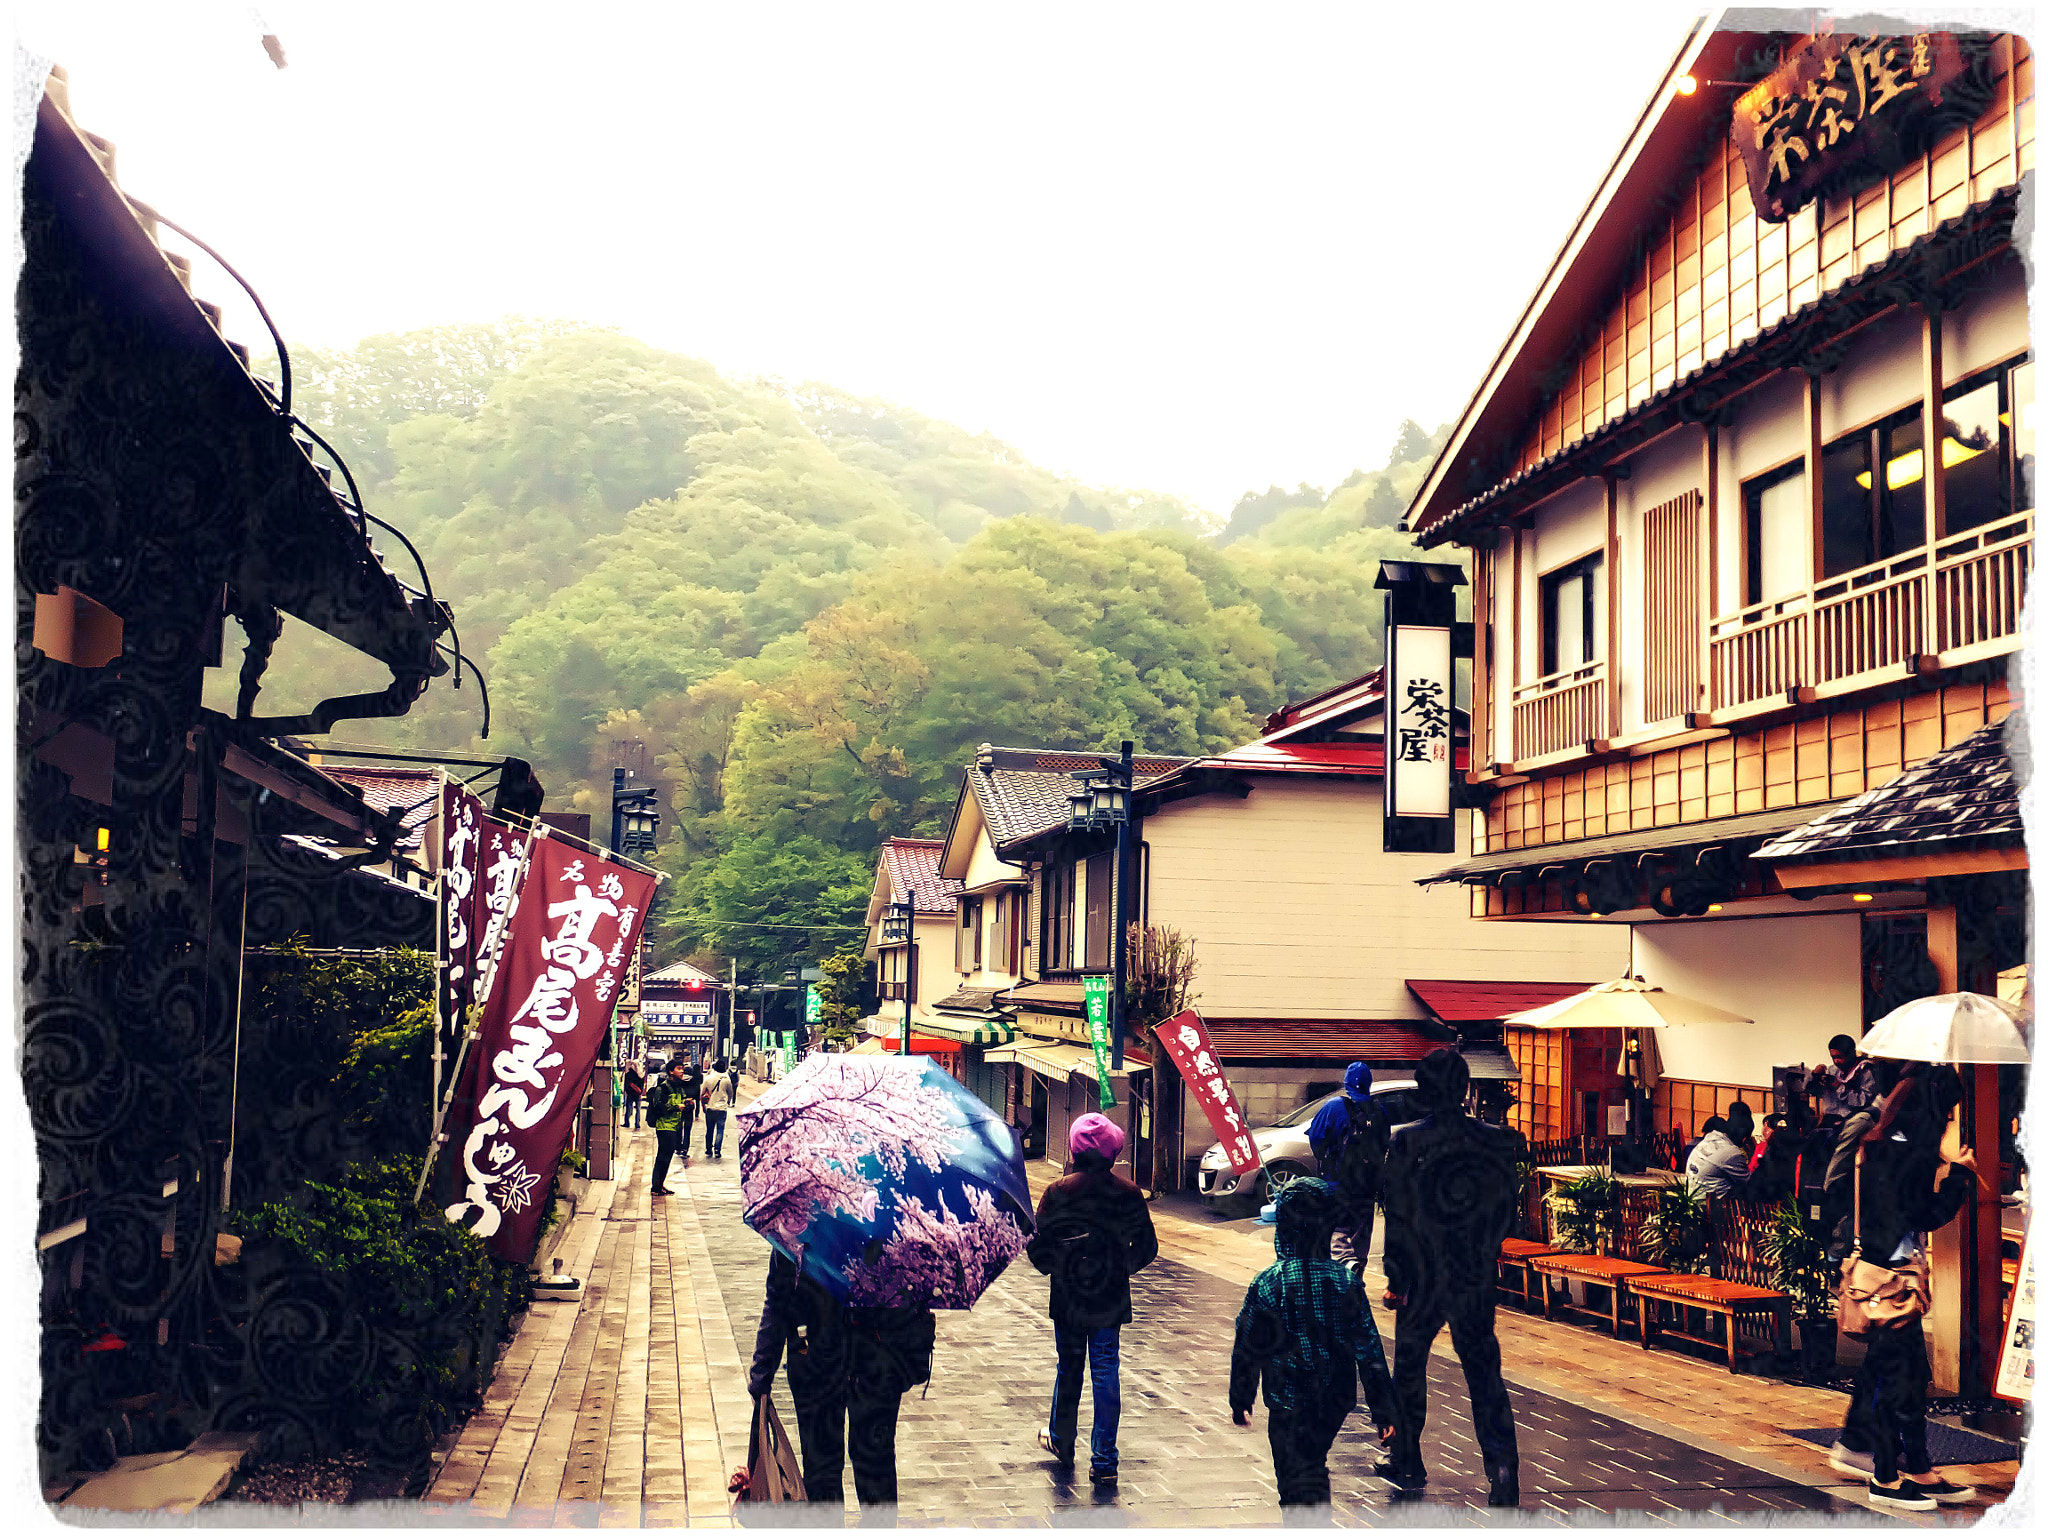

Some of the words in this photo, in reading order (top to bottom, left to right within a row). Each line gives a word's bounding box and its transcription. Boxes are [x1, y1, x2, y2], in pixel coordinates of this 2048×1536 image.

[1397, 678, 1449, 762] 栄茶屋
[560, 859, 624, 901] 名物
